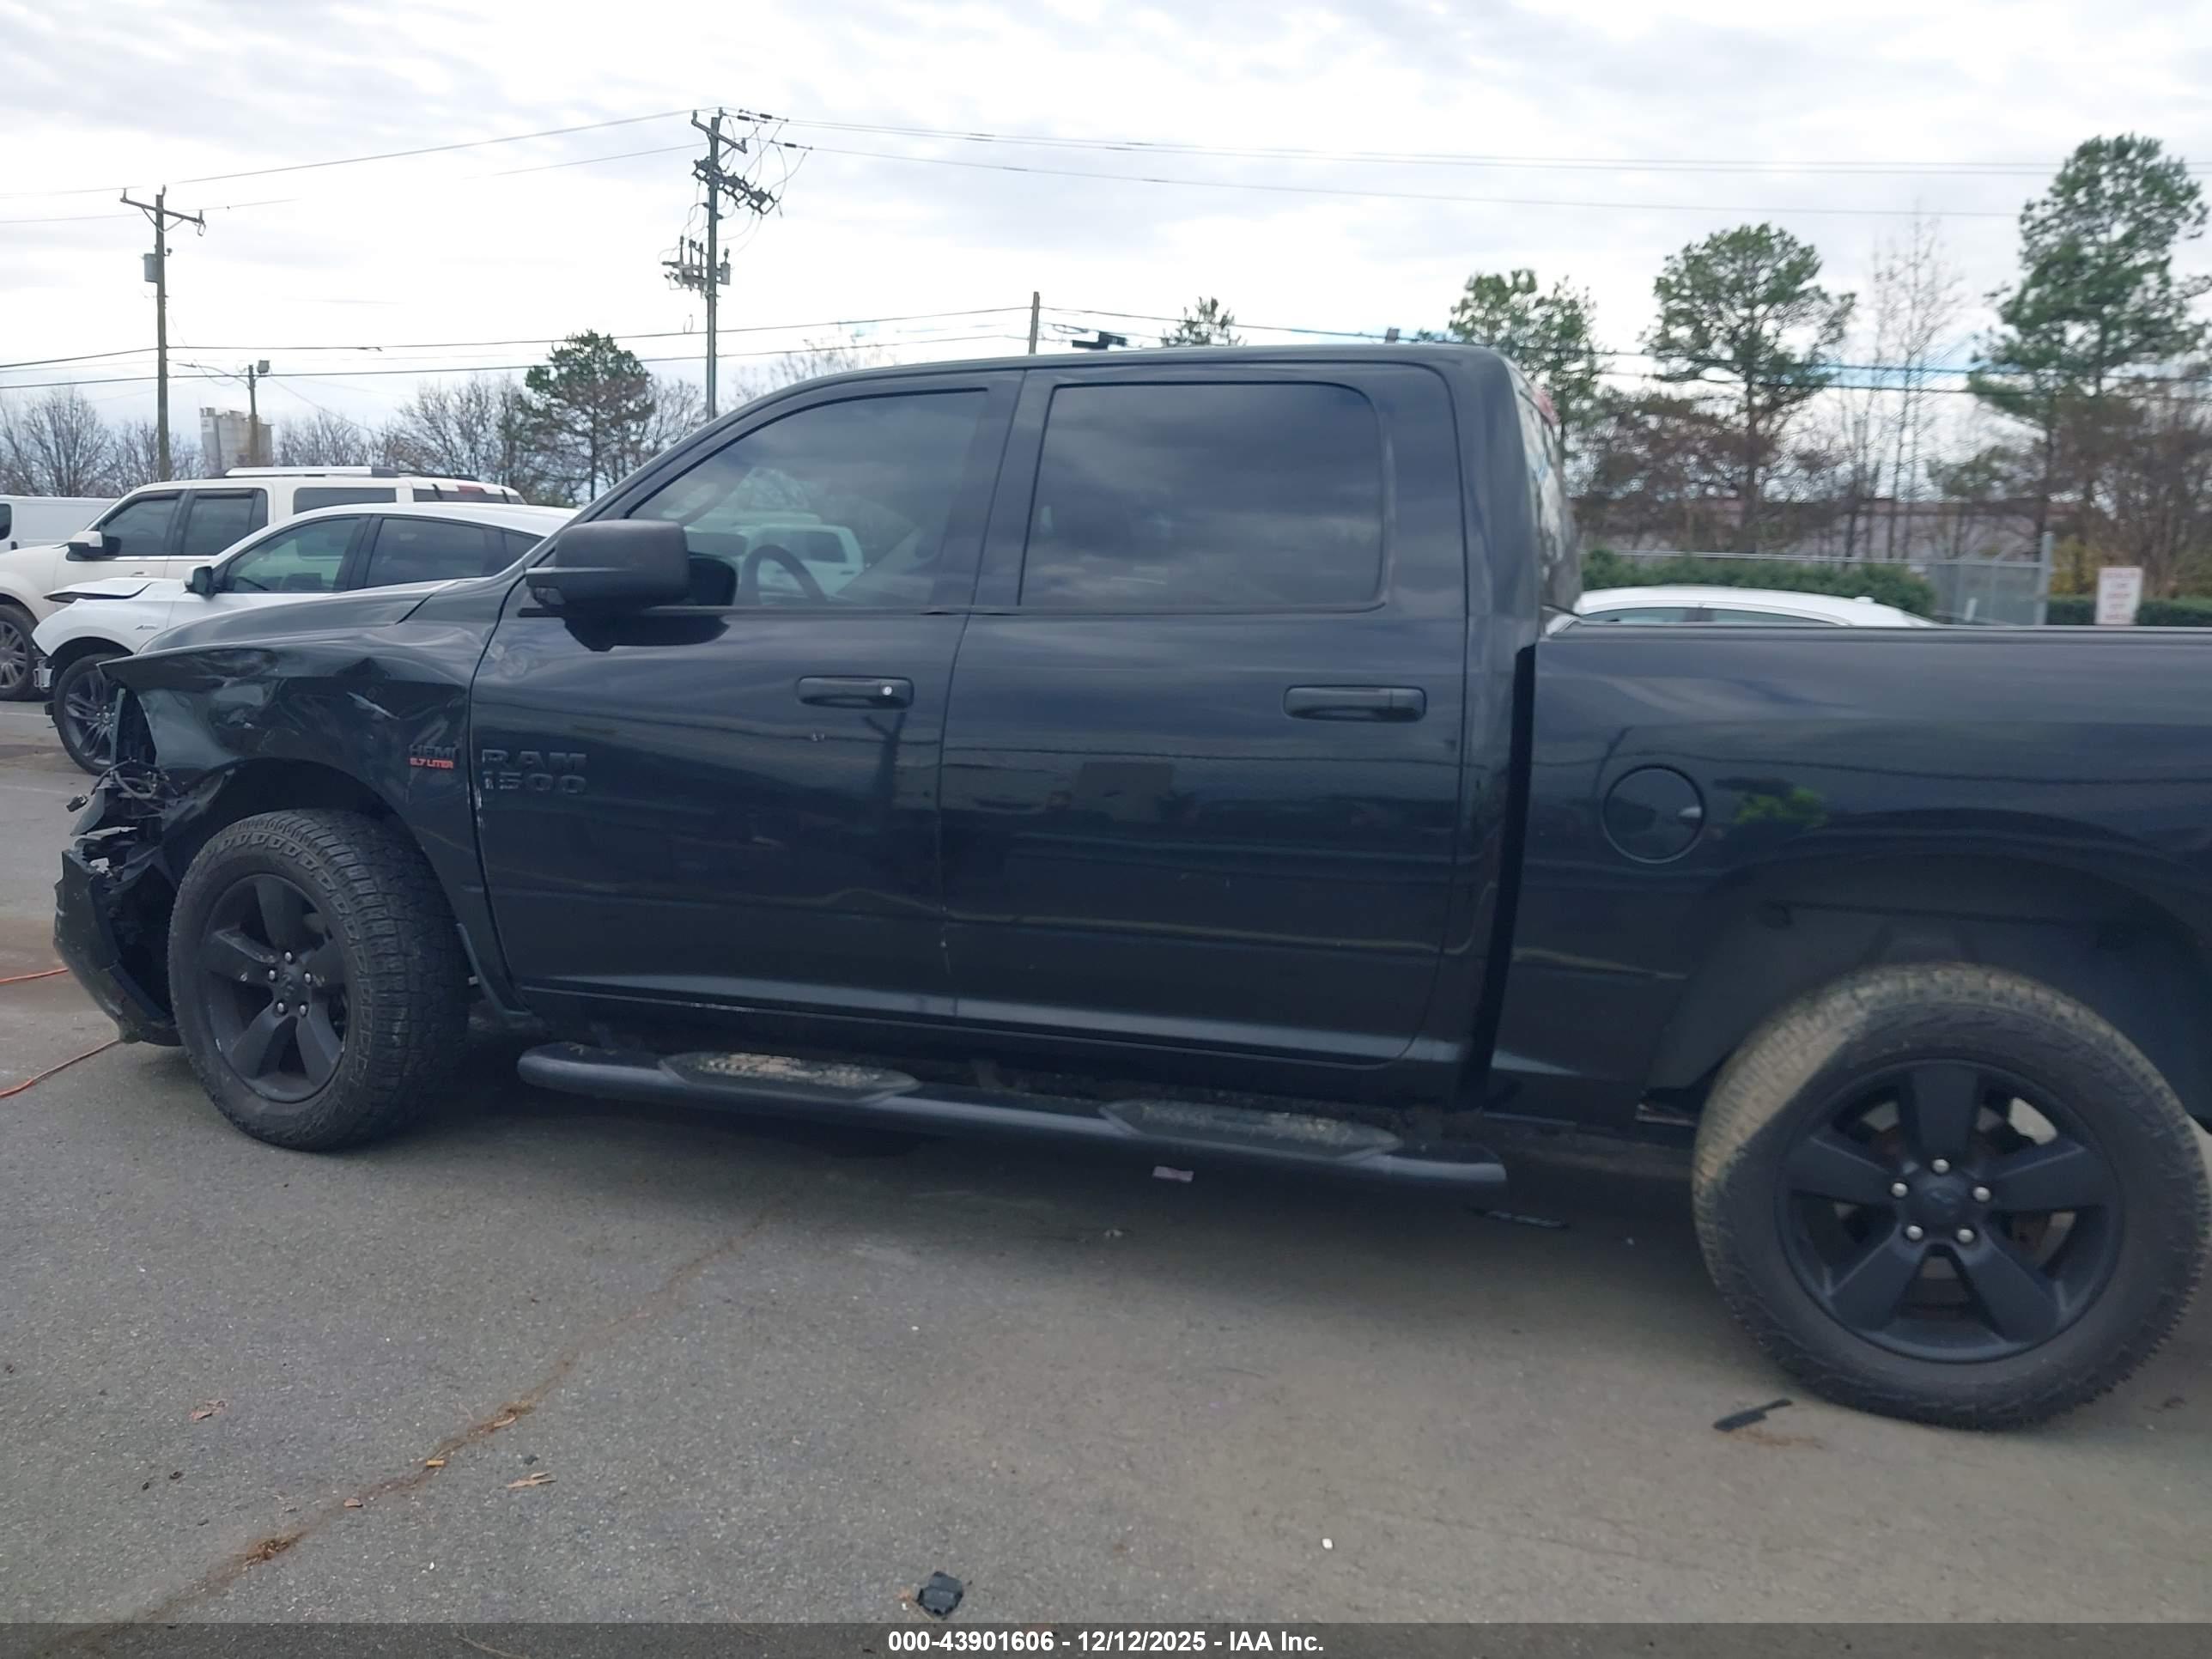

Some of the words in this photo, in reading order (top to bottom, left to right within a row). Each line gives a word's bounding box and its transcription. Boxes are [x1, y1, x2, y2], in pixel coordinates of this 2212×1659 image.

[408, 744, 456, 758] HEMI
[481, 748, 587, 771] RAM
[481, 770, 587, 794] 1500
